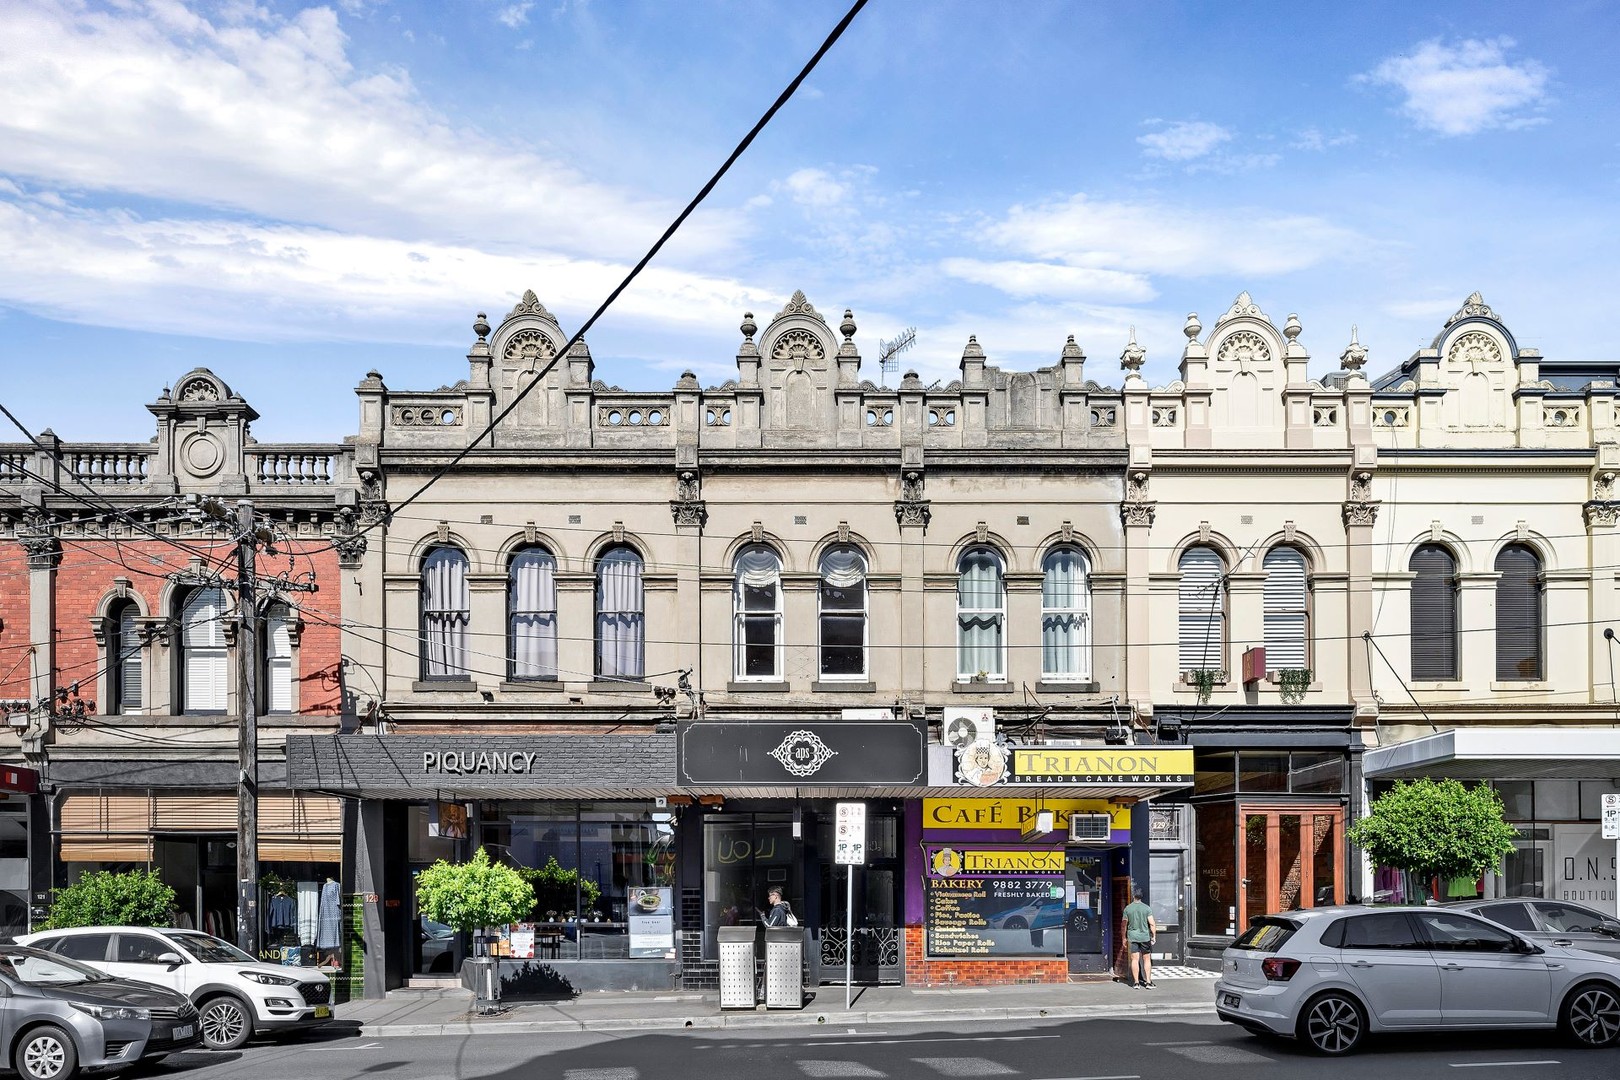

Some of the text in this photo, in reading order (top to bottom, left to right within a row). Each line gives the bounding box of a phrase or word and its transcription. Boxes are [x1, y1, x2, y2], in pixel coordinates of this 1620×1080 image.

[795, 747, 810, 761] aps
[1019, 752, 1158, 772] TRIANON
[424, 751, 537, 774] PIQUANCY
[1016, 806, 1120, 824] BKY
[966, 854, 1061, 868] TRIANON
[930, 880, 1052, 888] BAKERY 9882 3779
